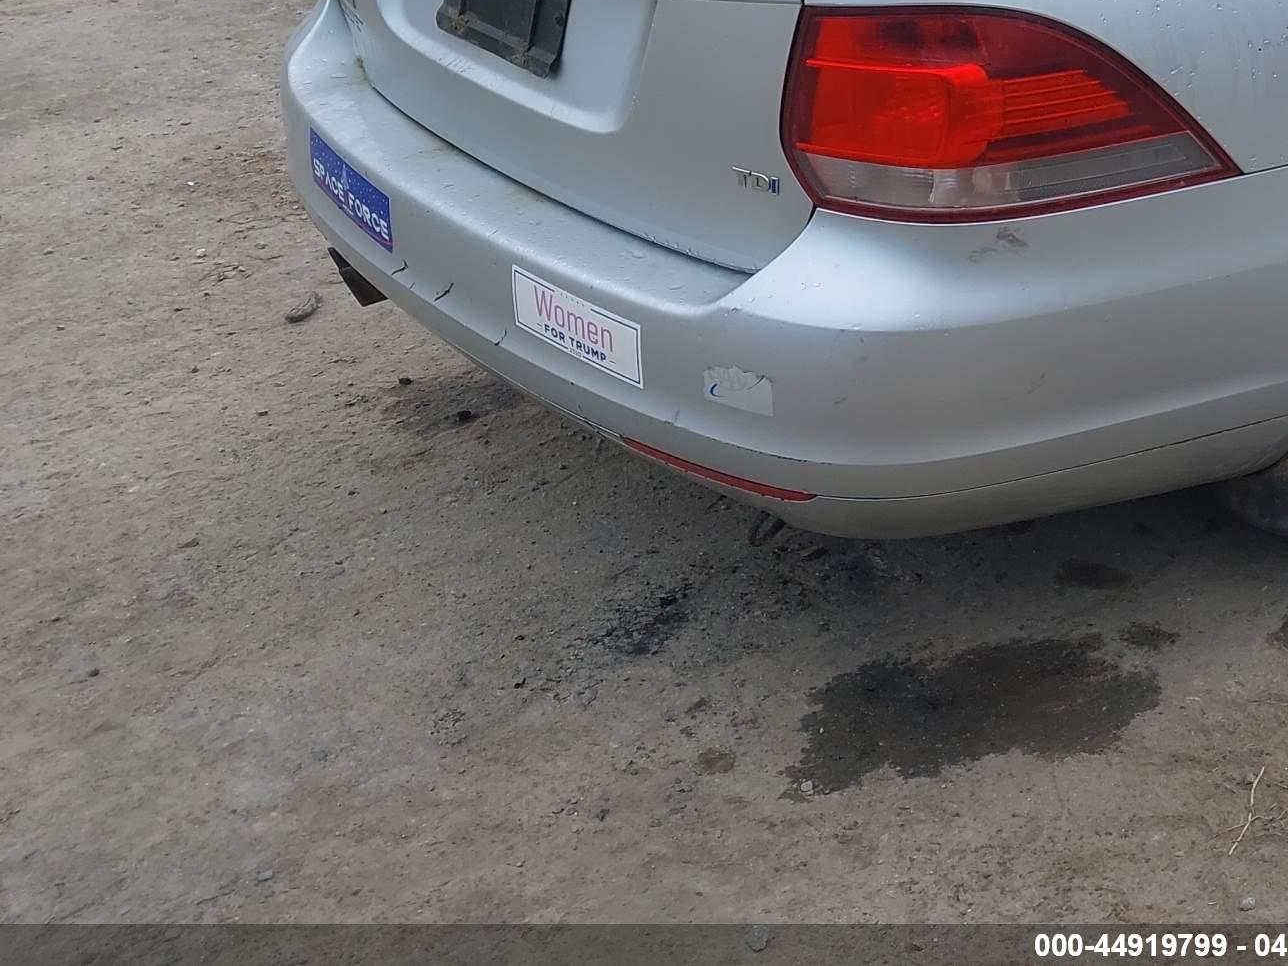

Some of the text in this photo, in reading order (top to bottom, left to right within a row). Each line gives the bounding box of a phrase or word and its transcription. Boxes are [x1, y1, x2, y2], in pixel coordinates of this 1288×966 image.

[313, 158, 390, 241] SPACE FORCE
[732, 166, 780, 195] TDI
[533, 285, 613, 353] Women
[544, 324, 607, 362] FOR TRUMP
